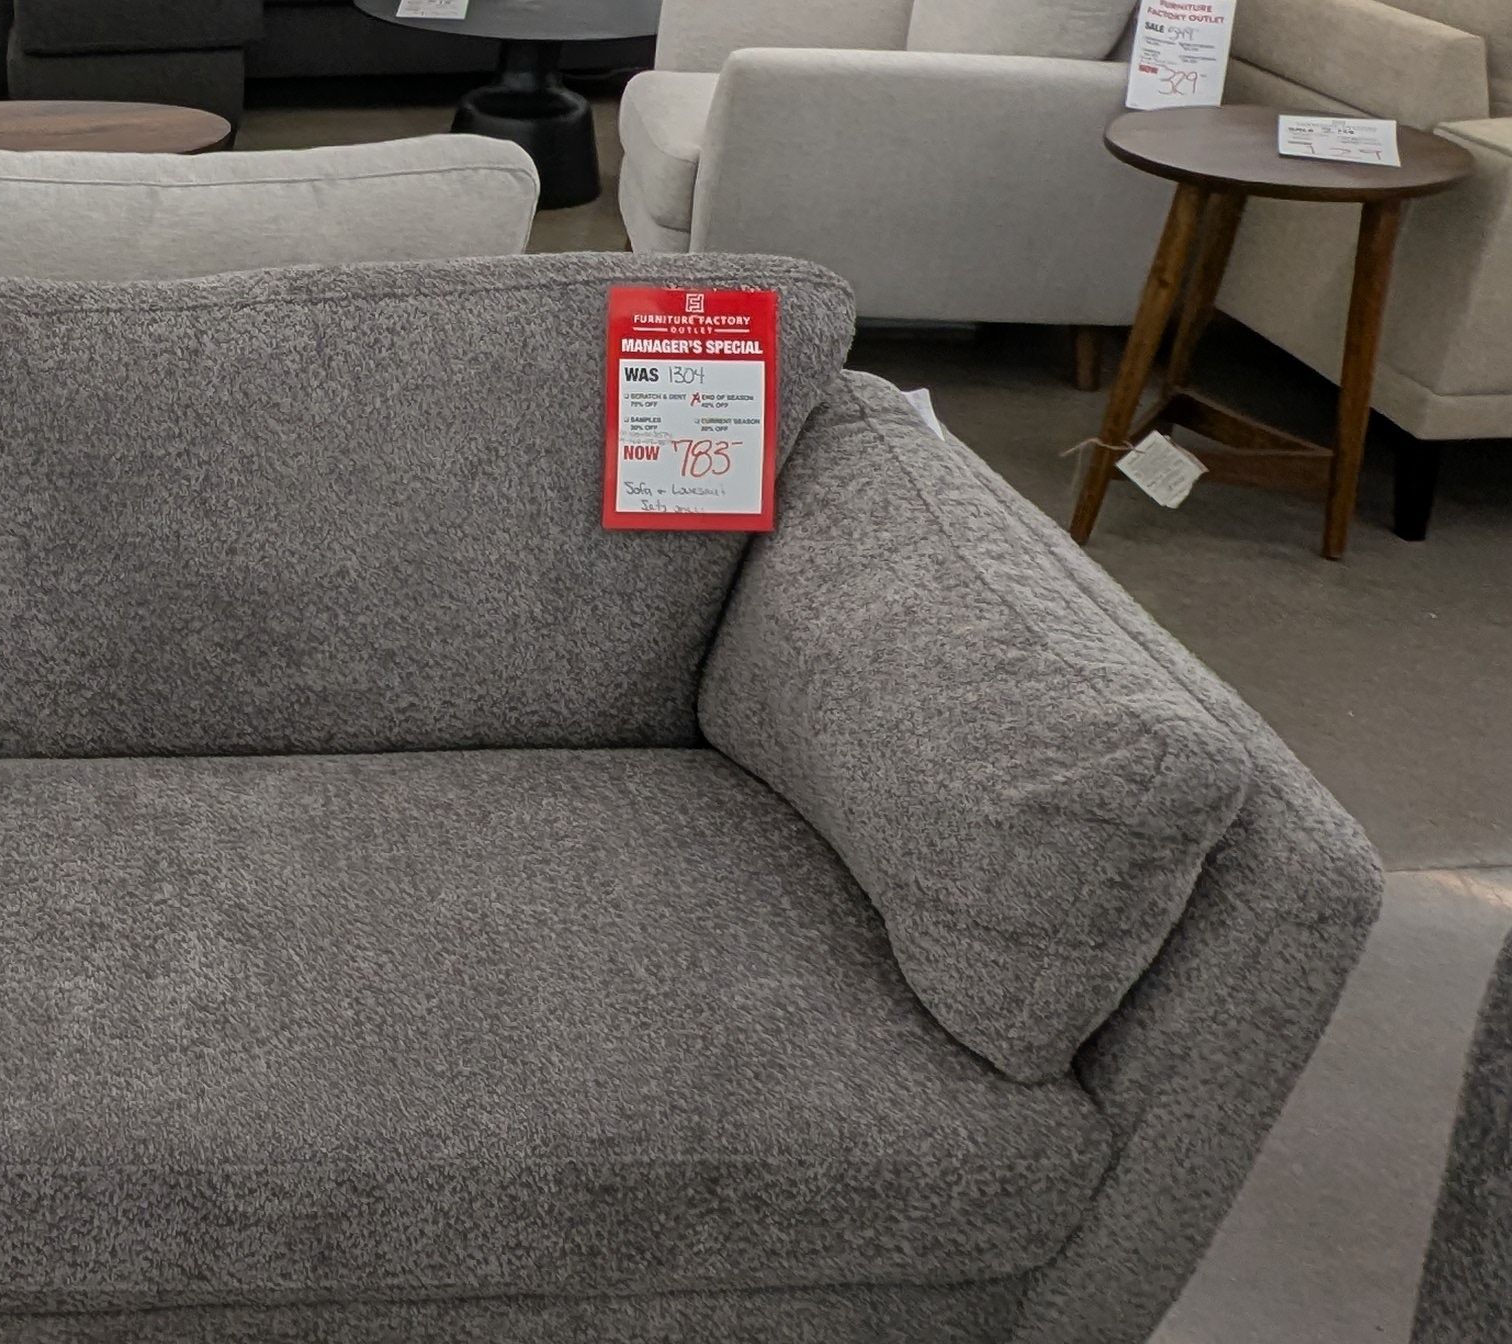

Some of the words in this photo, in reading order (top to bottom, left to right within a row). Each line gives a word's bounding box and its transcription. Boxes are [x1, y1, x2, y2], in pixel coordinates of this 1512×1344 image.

[1160, 0, 1212, 12] FURNITURE
[1147, 7, 1186, 22] FACTORY
[1188, 14, 1224, 24] OUTLET
[1145, 21, 1164, 33] SALE
[634, 315, 694, 325] FURNITURE
[699, 316, 750, 326] FACTORY
[621, 338, 702, 354] MANAGER'S
[706, 340, 763, 355] SPECIAL
[624, 367, 659, 382] WAS
[668, 366, 704, 384] 1304
[624, 445, 660, 460] NOW
[624, 481, 653, 496] Sofa
